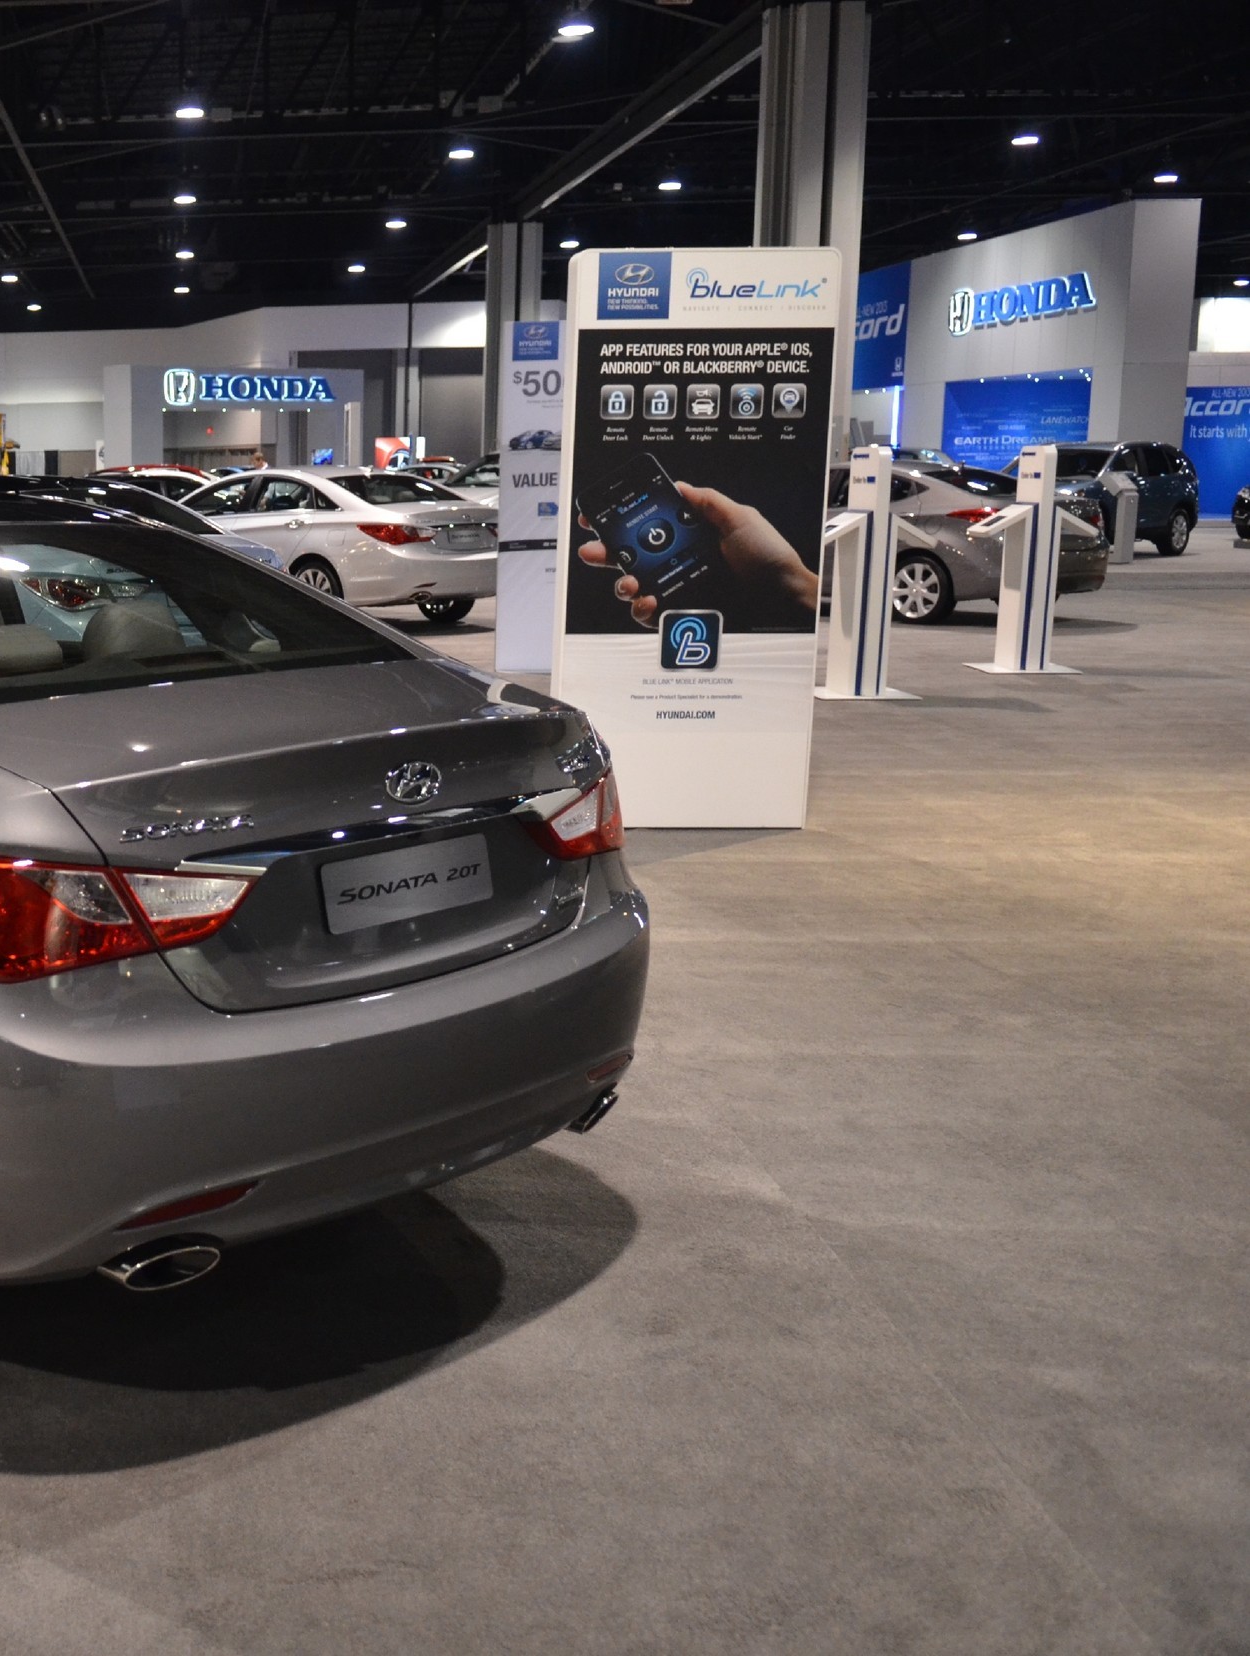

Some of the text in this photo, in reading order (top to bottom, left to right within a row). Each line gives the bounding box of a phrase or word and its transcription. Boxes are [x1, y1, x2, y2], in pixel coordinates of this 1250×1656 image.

[607, 287, 659, 297] HYUNDAI
[972, 271, 1097, 327] HONDA
[855, 303, 905, 340] ord
[600, 344, 625, 356] APP
[626, 343, 684, 356] FEATURES
[687, 343, 710, 356] FOR
[712, 343, 743, 356] YOUR
[663, 361, 680, 373] OR
[767, 360, 809, 373] DEVICE.
[200, 373, 336, 402] HONDA
[512, 369, 564, 397] $50
[1184, 397, 1250, 416] ccor
[1190, 423, 1248, 438] It starts with
[954, 436, 998, 445] EARTH
[512, 472, 558, 488] VALUE
[656, 710, 716, 719] HYUNDAI.COM
[337, 872, 438, 905] SONATA
